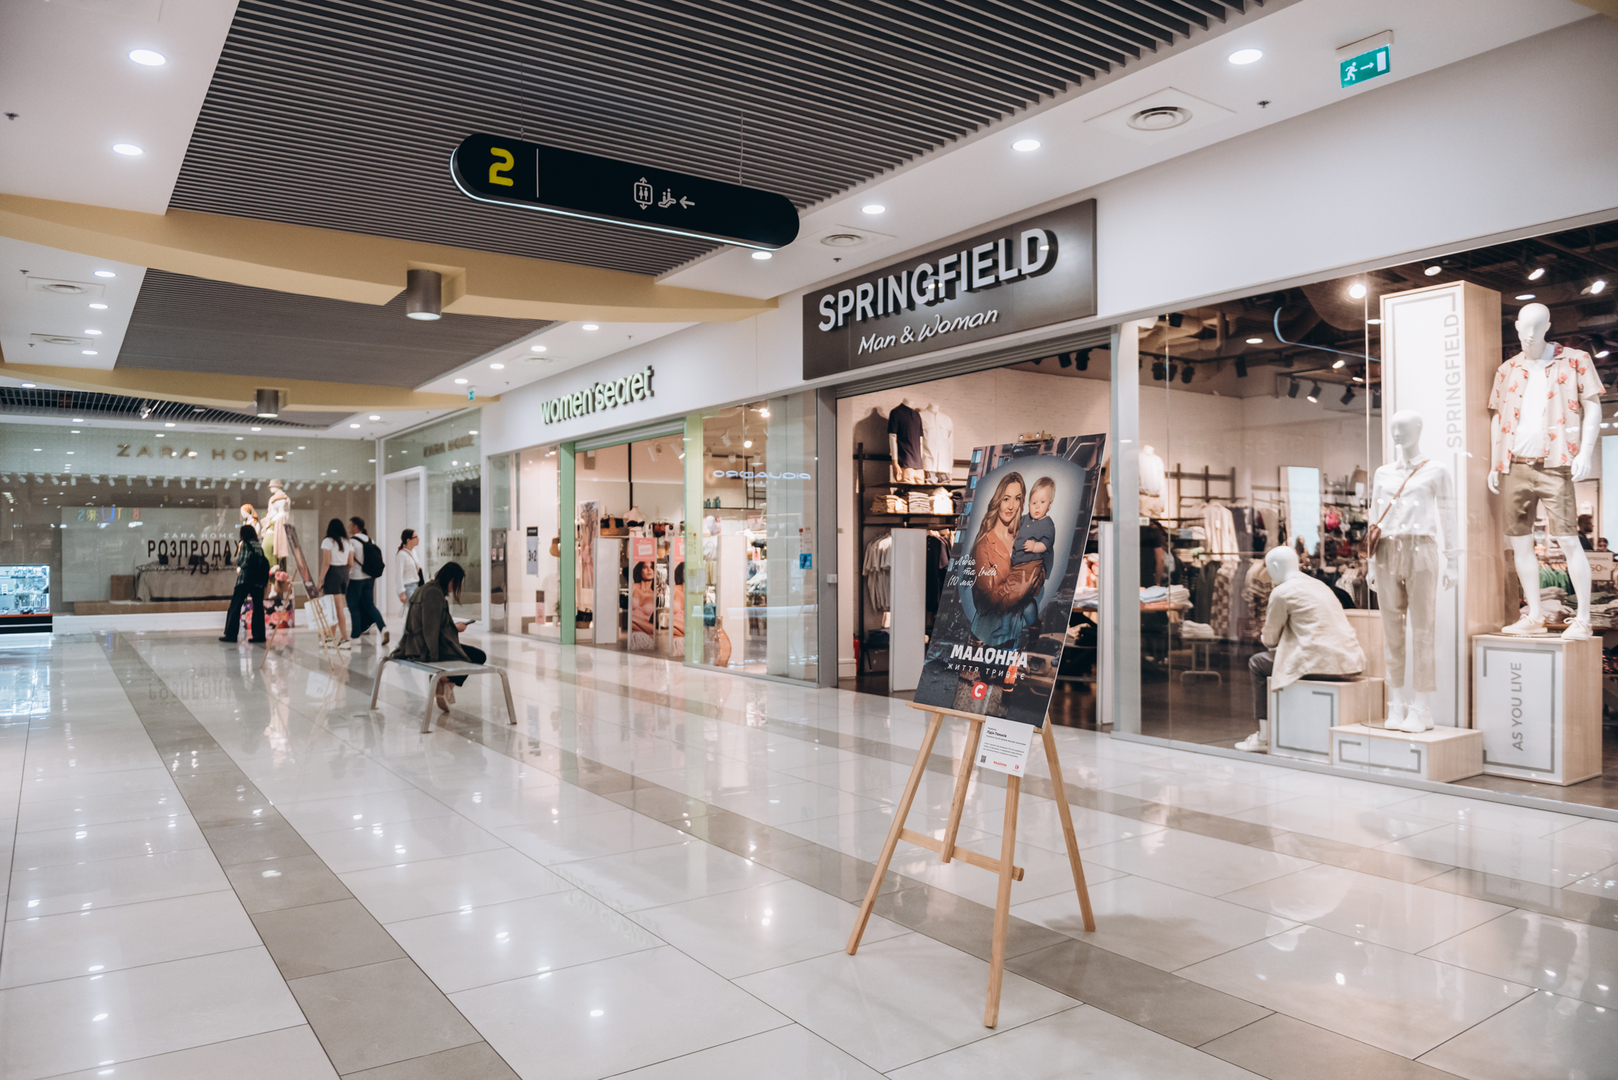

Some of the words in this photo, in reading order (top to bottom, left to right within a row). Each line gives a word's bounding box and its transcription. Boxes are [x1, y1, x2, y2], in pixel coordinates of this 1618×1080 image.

[489, 147, 514, 187] 2
[818, 228, 1058, 332] SPRINGFIELD
[857, 333, 896, 355] Man
[900, 326, 915, 343] &
[917, 309, 999, 342] Woman
[1444, 314, 1463, 448] SPRINGFIELD
[117, 444, 197, 459] ZARA
[212, 448, 287, 463] HOME
[946, 663, 980, 674] ЖИТТЯ
[985, 668, 1026, 681] ТРИВАЄ
[950, 644, 1028, 669] МАДОННА
[1510, 662, 1522, 693] LIVE
[1511, 697, 1523, 728] YOU
[1512, 731, 1524, 752] AS
